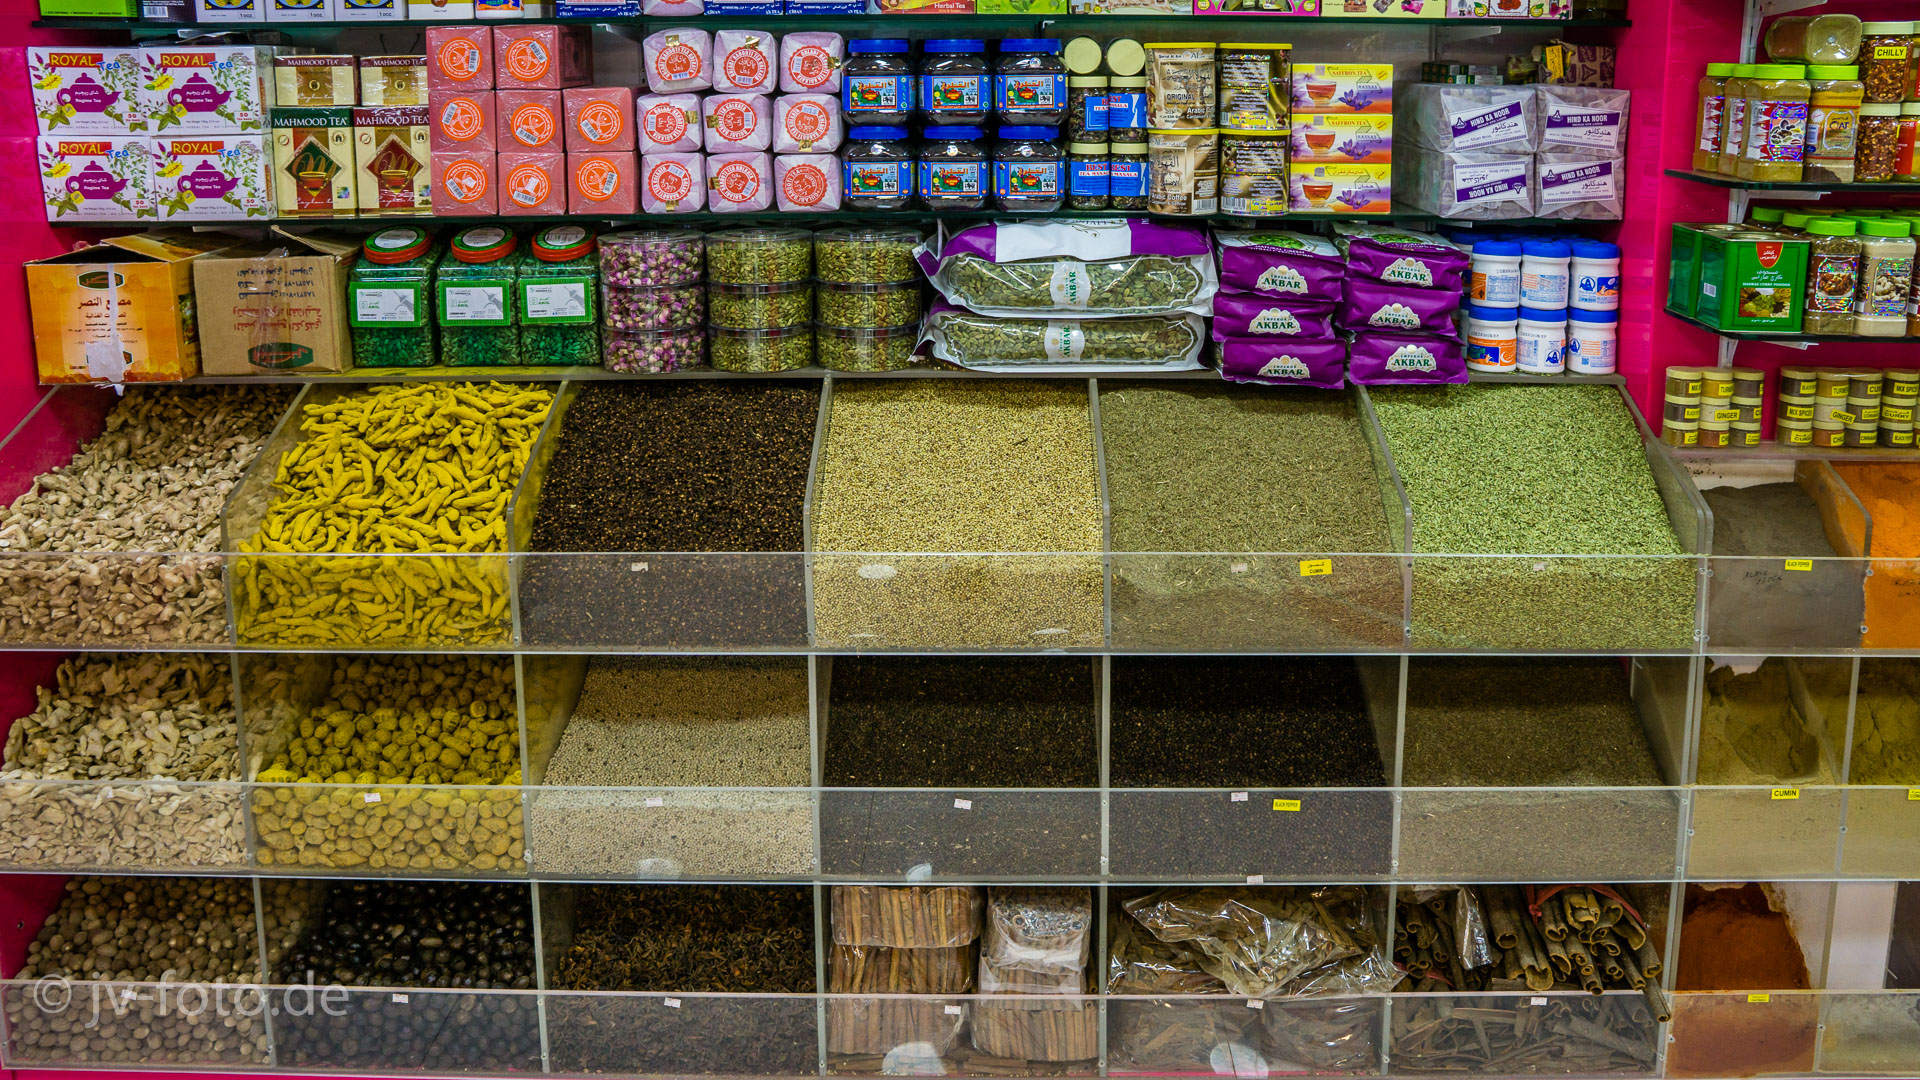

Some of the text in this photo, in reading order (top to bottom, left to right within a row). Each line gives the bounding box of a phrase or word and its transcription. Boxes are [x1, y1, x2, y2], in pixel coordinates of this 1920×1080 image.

[1877, 49, 1905, 57] CHILLY
[51, 55, 121, 71] ROYAL Tea
[162, 55, 233, 71] ROYAL Tea
[274, 117, 348, 126] MAHMOOD TEA
[356, 116, 429, 126] MAHMOOD TEA
[1470, 108, 1510, 127] HIND KA NOOR
[61, 143, 130, 160] ROYAL Tea
[173, 143, 241, 159] ROYAL Tea
[1561, 172, 1576, 181] HIND
[1585, 166, 1601, 175] NOOR
[1469, 189, 1486, 198] NOOR
[1494, 183, 1509, 192] HIND
[1390, 270, 1426, 282] AKBAR
[1069, 271, 1077, 303] AKBAR
[1263, 278, 1301, 290] AKBAR
[78, 297, 102, 310] النصر
[1256, 321, 1294, 330] AKBAR
[1377, 316, 1414, 327] AKBAR
[1063, 326, 1071, 357] AKBAR
[1394, 358, 1430, 367] AKBAR
[1266, 368, 1304, 377] AKBAR
[1833, 412, 1854, 421] GINGER
